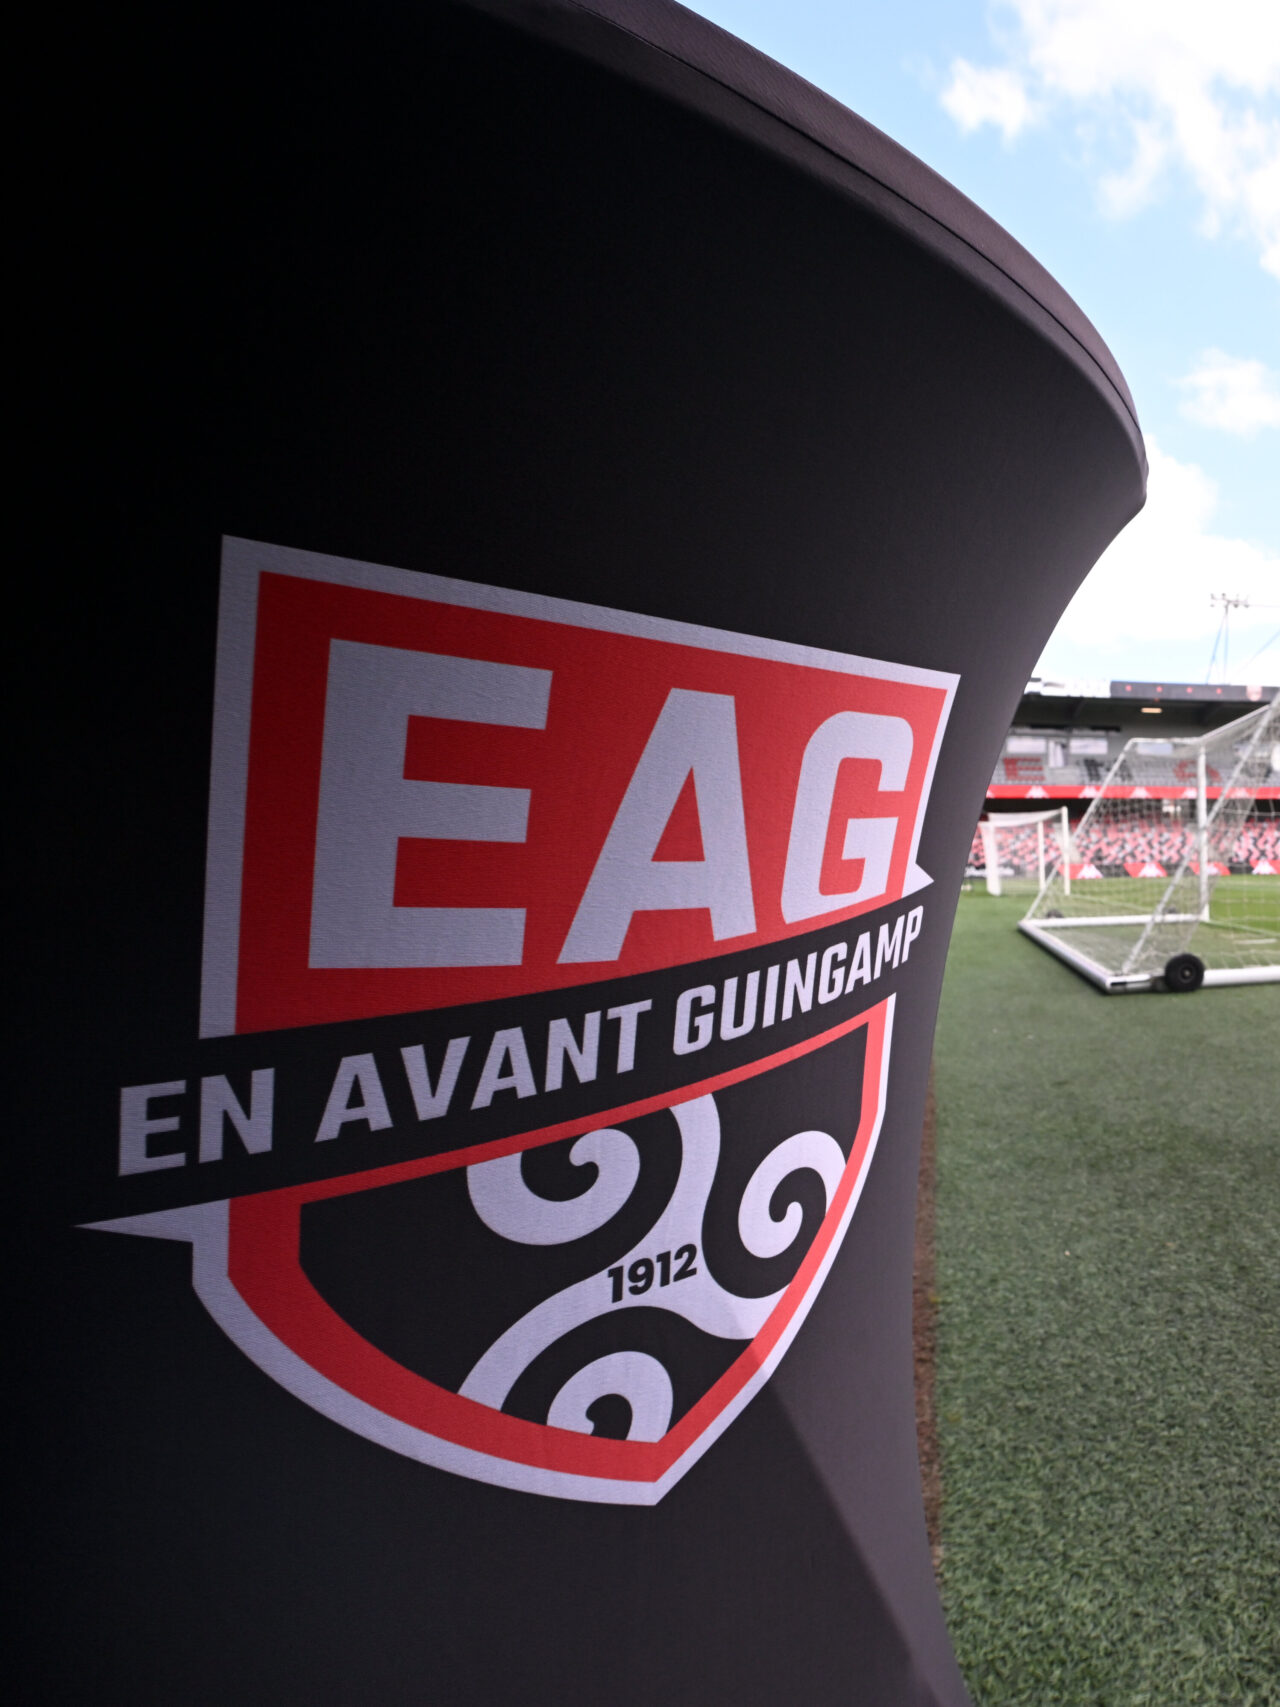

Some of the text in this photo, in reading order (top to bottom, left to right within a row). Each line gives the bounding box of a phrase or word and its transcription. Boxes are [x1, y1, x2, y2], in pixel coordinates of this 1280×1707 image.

[308, 638, 914, 969] EAG
[118, 904, 925, 1177] EN AVANT GUINGAMP
[607, 1243, 698, 1303] 1912
